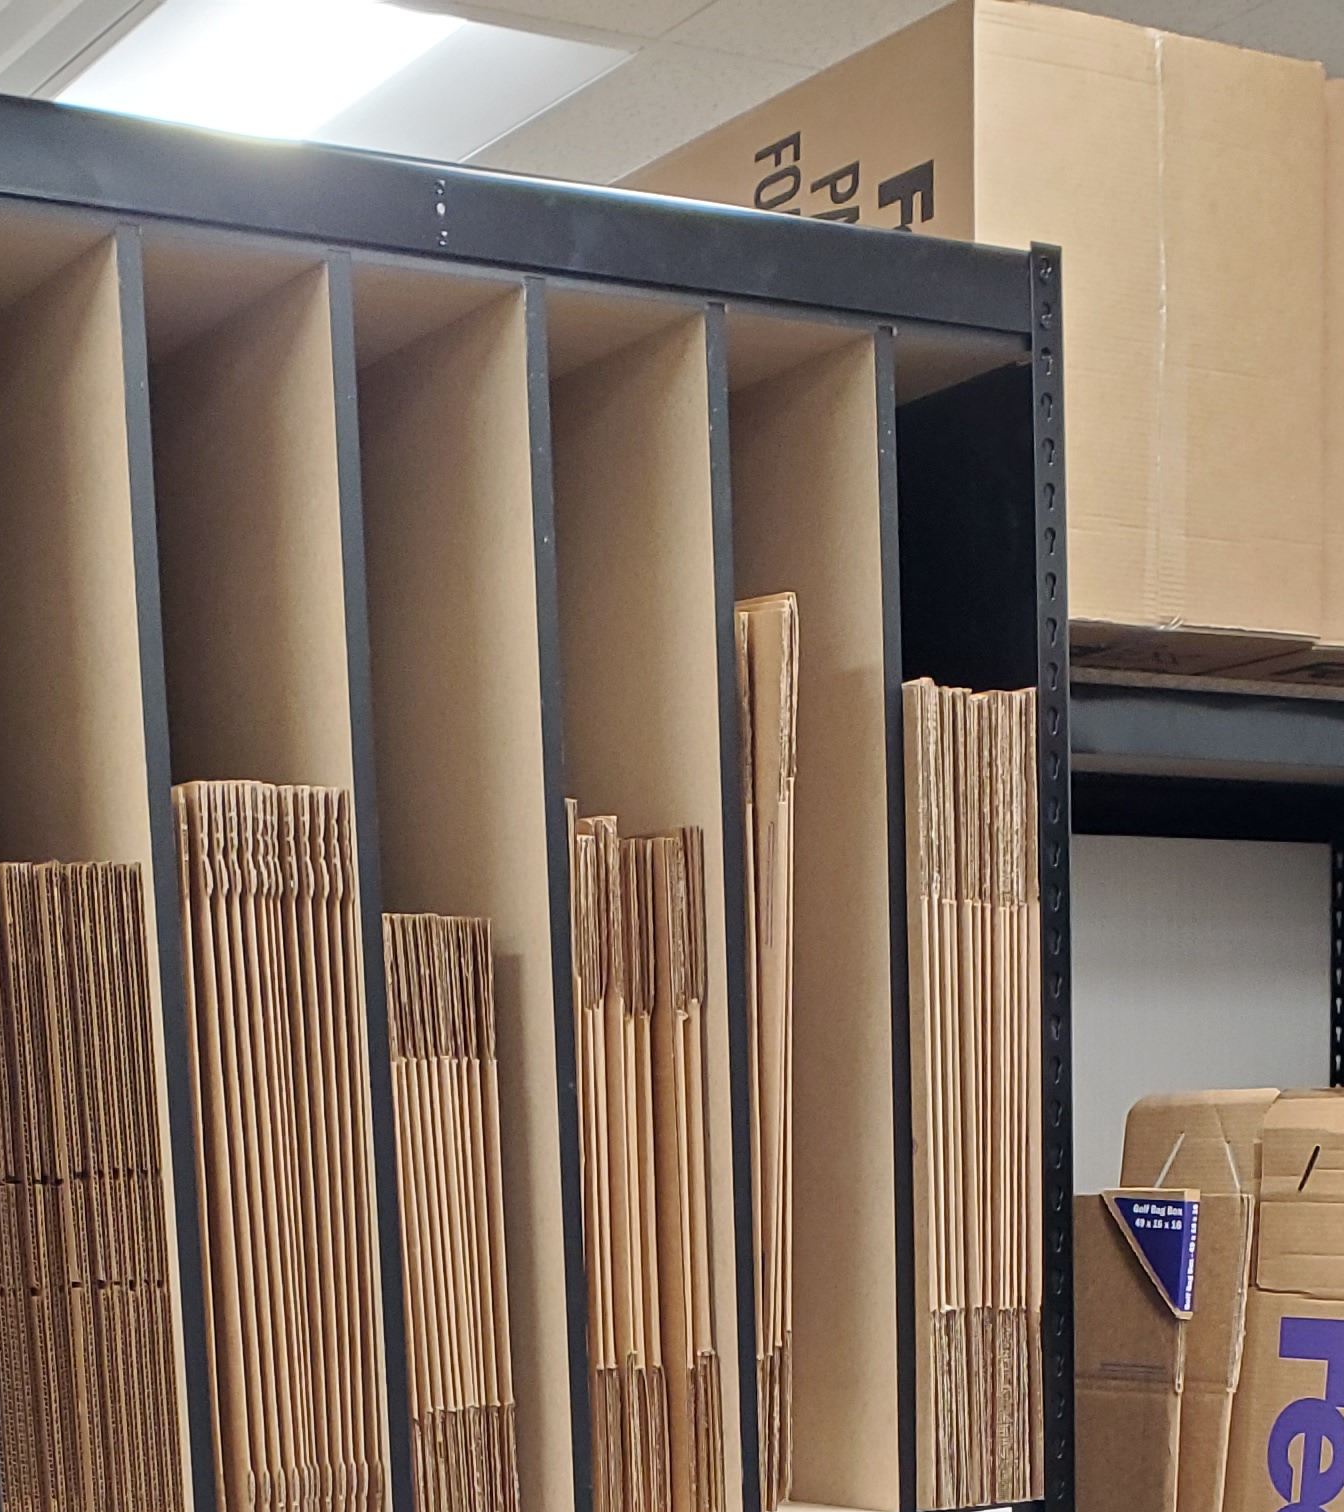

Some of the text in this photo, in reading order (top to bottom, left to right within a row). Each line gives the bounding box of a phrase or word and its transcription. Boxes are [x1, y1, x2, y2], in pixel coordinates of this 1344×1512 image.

[1132, 1203, 1184, 1217] Golf Bag Box
